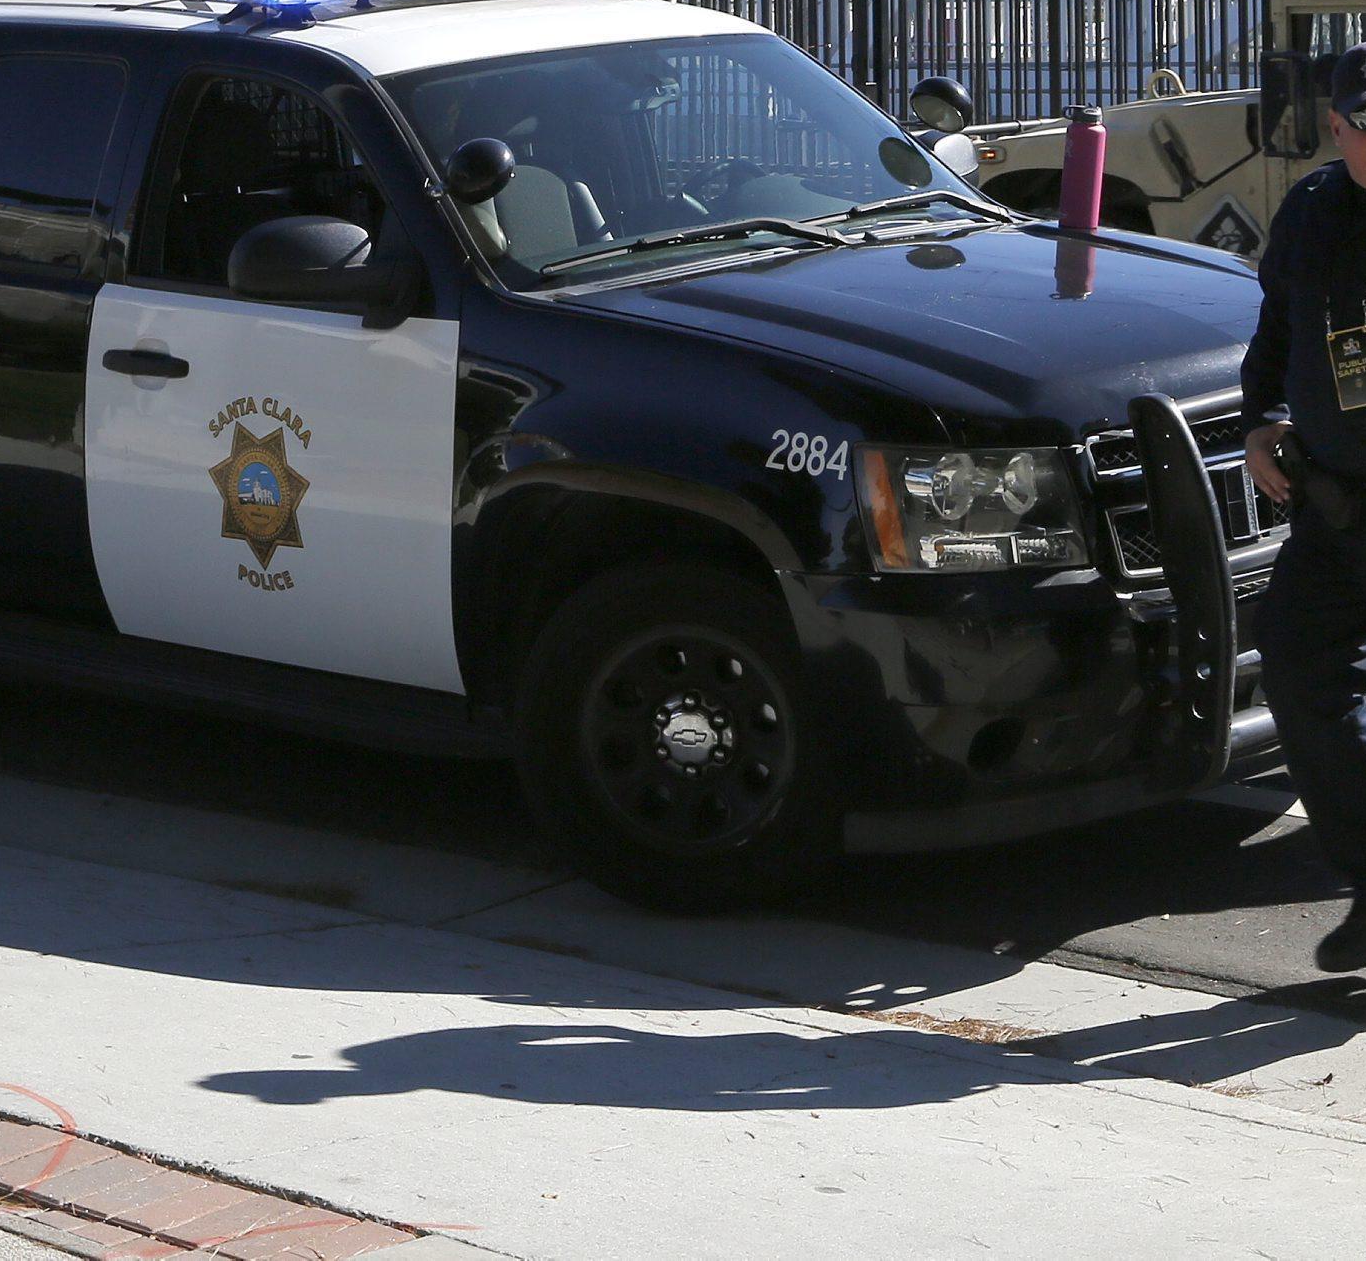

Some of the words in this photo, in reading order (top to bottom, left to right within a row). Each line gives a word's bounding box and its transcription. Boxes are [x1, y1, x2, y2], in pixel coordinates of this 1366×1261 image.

[208, 396, 259, 439] SANTA
[261, 397, 314, 450] CLARA
[765, 428, 849, 481] 2884
[237, 563, 295, 592] POLICE
